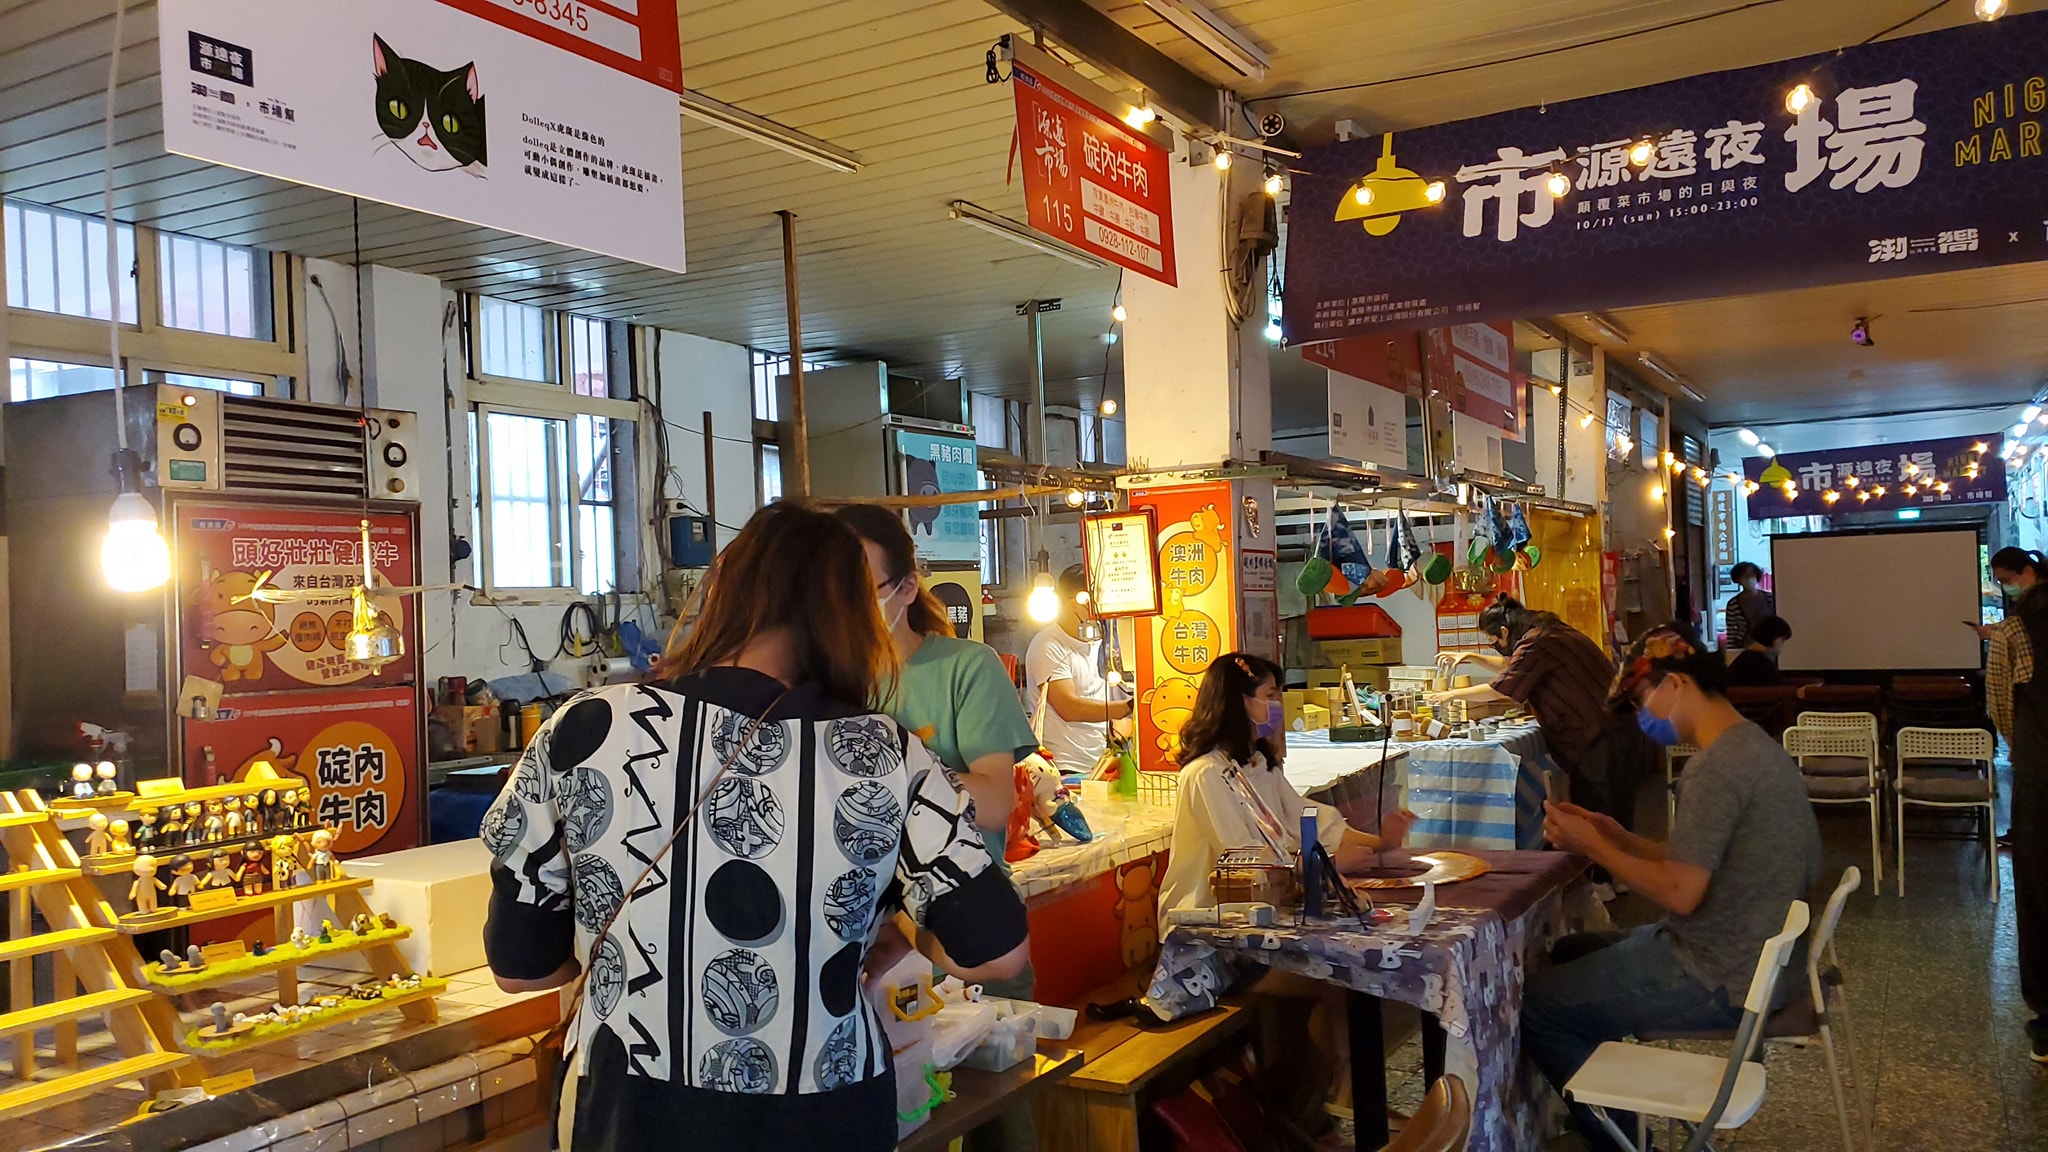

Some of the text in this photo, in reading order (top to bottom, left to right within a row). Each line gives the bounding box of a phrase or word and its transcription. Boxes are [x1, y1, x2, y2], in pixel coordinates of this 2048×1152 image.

[513, 0, 588, 31] -8345
[1082, 130, 1149, 198] 碇內牛肉
[1455, 77, 1927, 242] 市 源遠夜 場
[1577, 176, 1758, 215] 顛覆菜市場的日與夜
[1043, 194, 1073, 233] 115
[1576, 196, 1758, 231] 10/17 (sun) 15:00-23:00
[1098, 226, 1150, 262] 0928-112-107
[1798, 461, 1834, 491] 市
[1898, 451, 1937, 483] 場
[232, 537, 400, 567] 頭好壯壯健康牛
[1170, 543, 1205, 562] 澳洲
[1170, 567, 1205, 587] 牛肉
[947, 605, 968, 623] 黑豬
[1174, 621, 1209, 640] 台灣
[1174, 645, 1209, 664] 牛肉
[317, 745, 385, 785] 碇內
[319, 790, 386, 830] 牛肉
